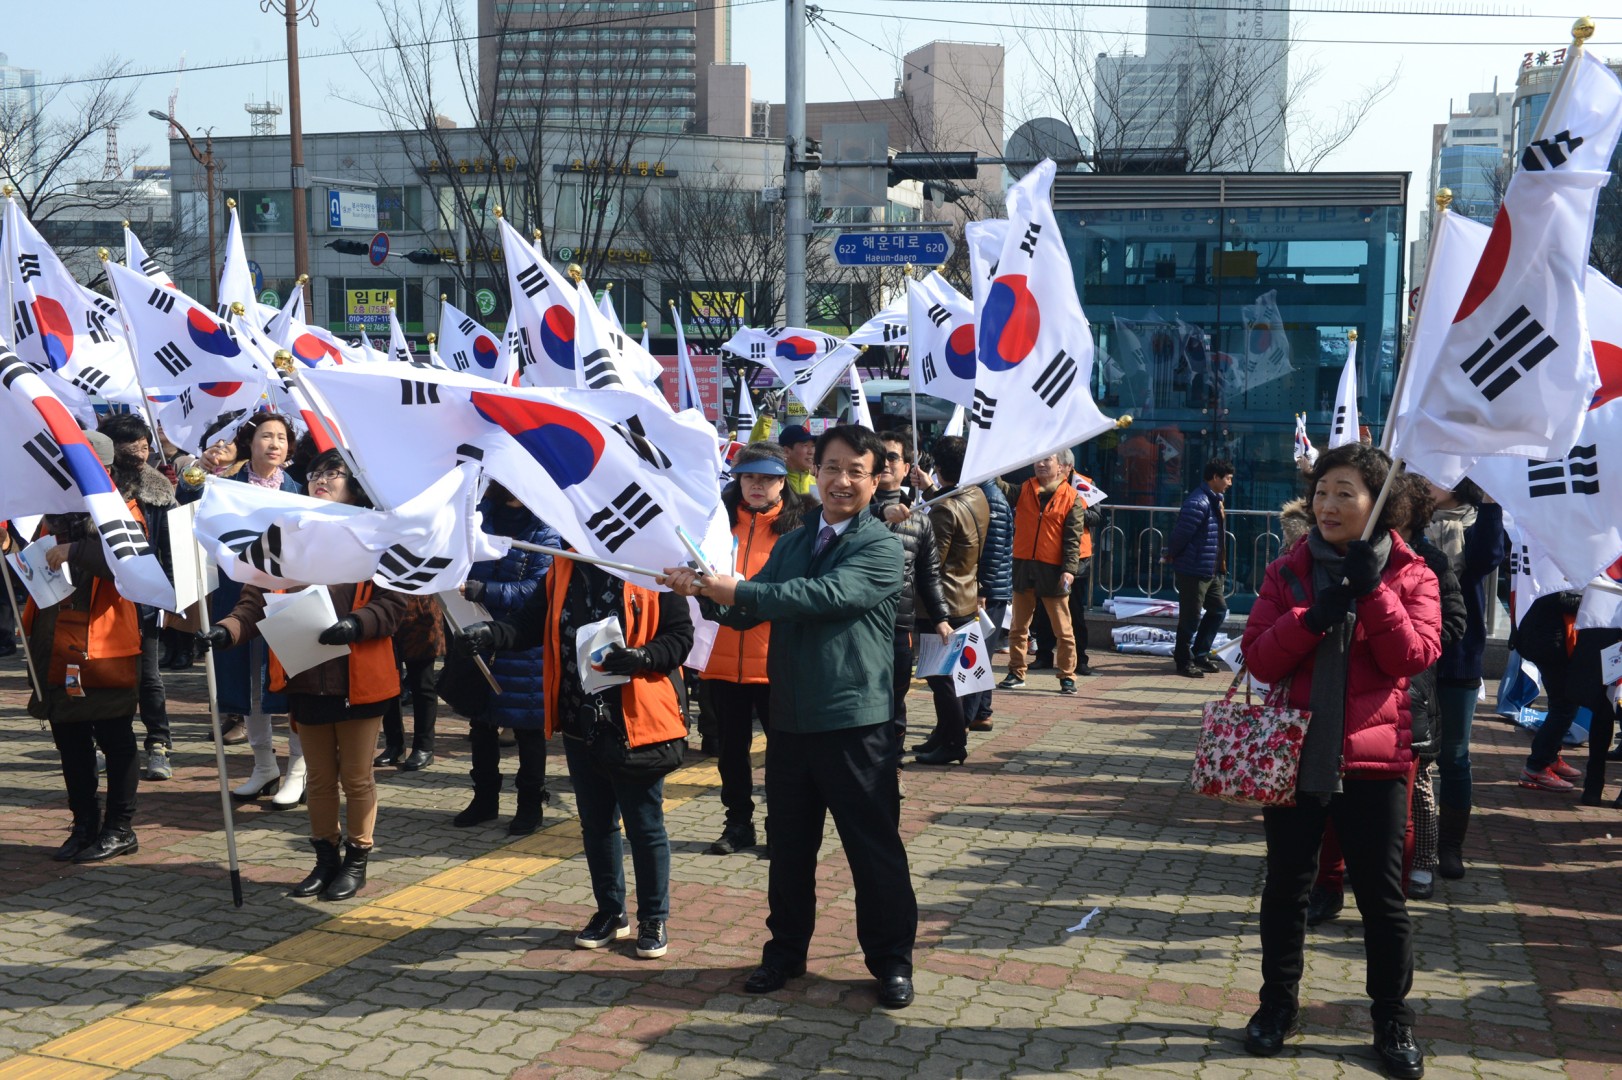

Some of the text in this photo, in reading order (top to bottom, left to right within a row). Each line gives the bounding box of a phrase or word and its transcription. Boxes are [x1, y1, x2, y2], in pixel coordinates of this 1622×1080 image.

[862, 235, 920, 250] 해운대로
[839, 244, 856, 254] 622
[925, 243, 944, 253] 620
[865, 253, 917, 262] Haeun-daero
